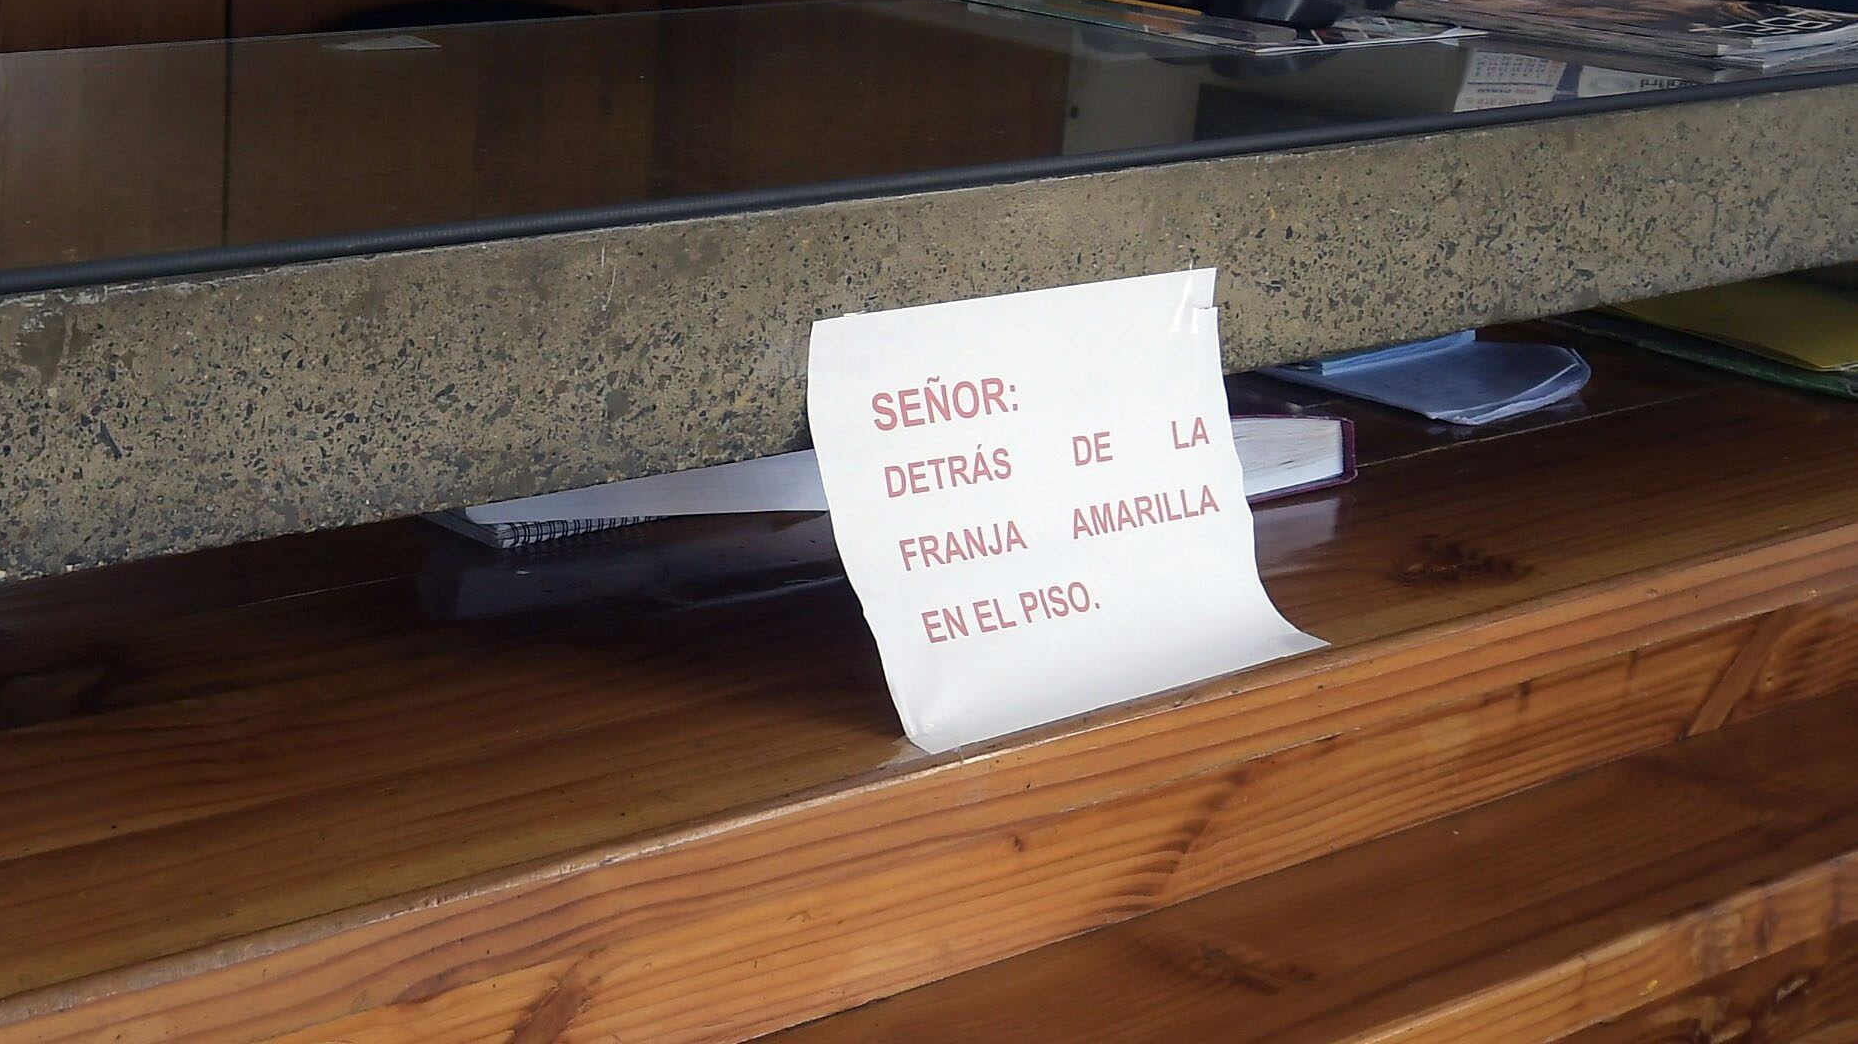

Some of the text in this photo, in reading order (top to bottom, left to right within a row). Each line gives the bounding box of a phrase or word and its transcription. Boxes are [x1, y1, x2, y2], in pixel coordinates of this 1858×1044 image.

[870, 376, 1021, 431] SEÑOR:
[884, 416, 1210, 498] DETRÁS DE LA
[899, 484, 1220, 572] FRANJA AMARILLA
[921, 581, 1101, 645] EN EL PISO.
